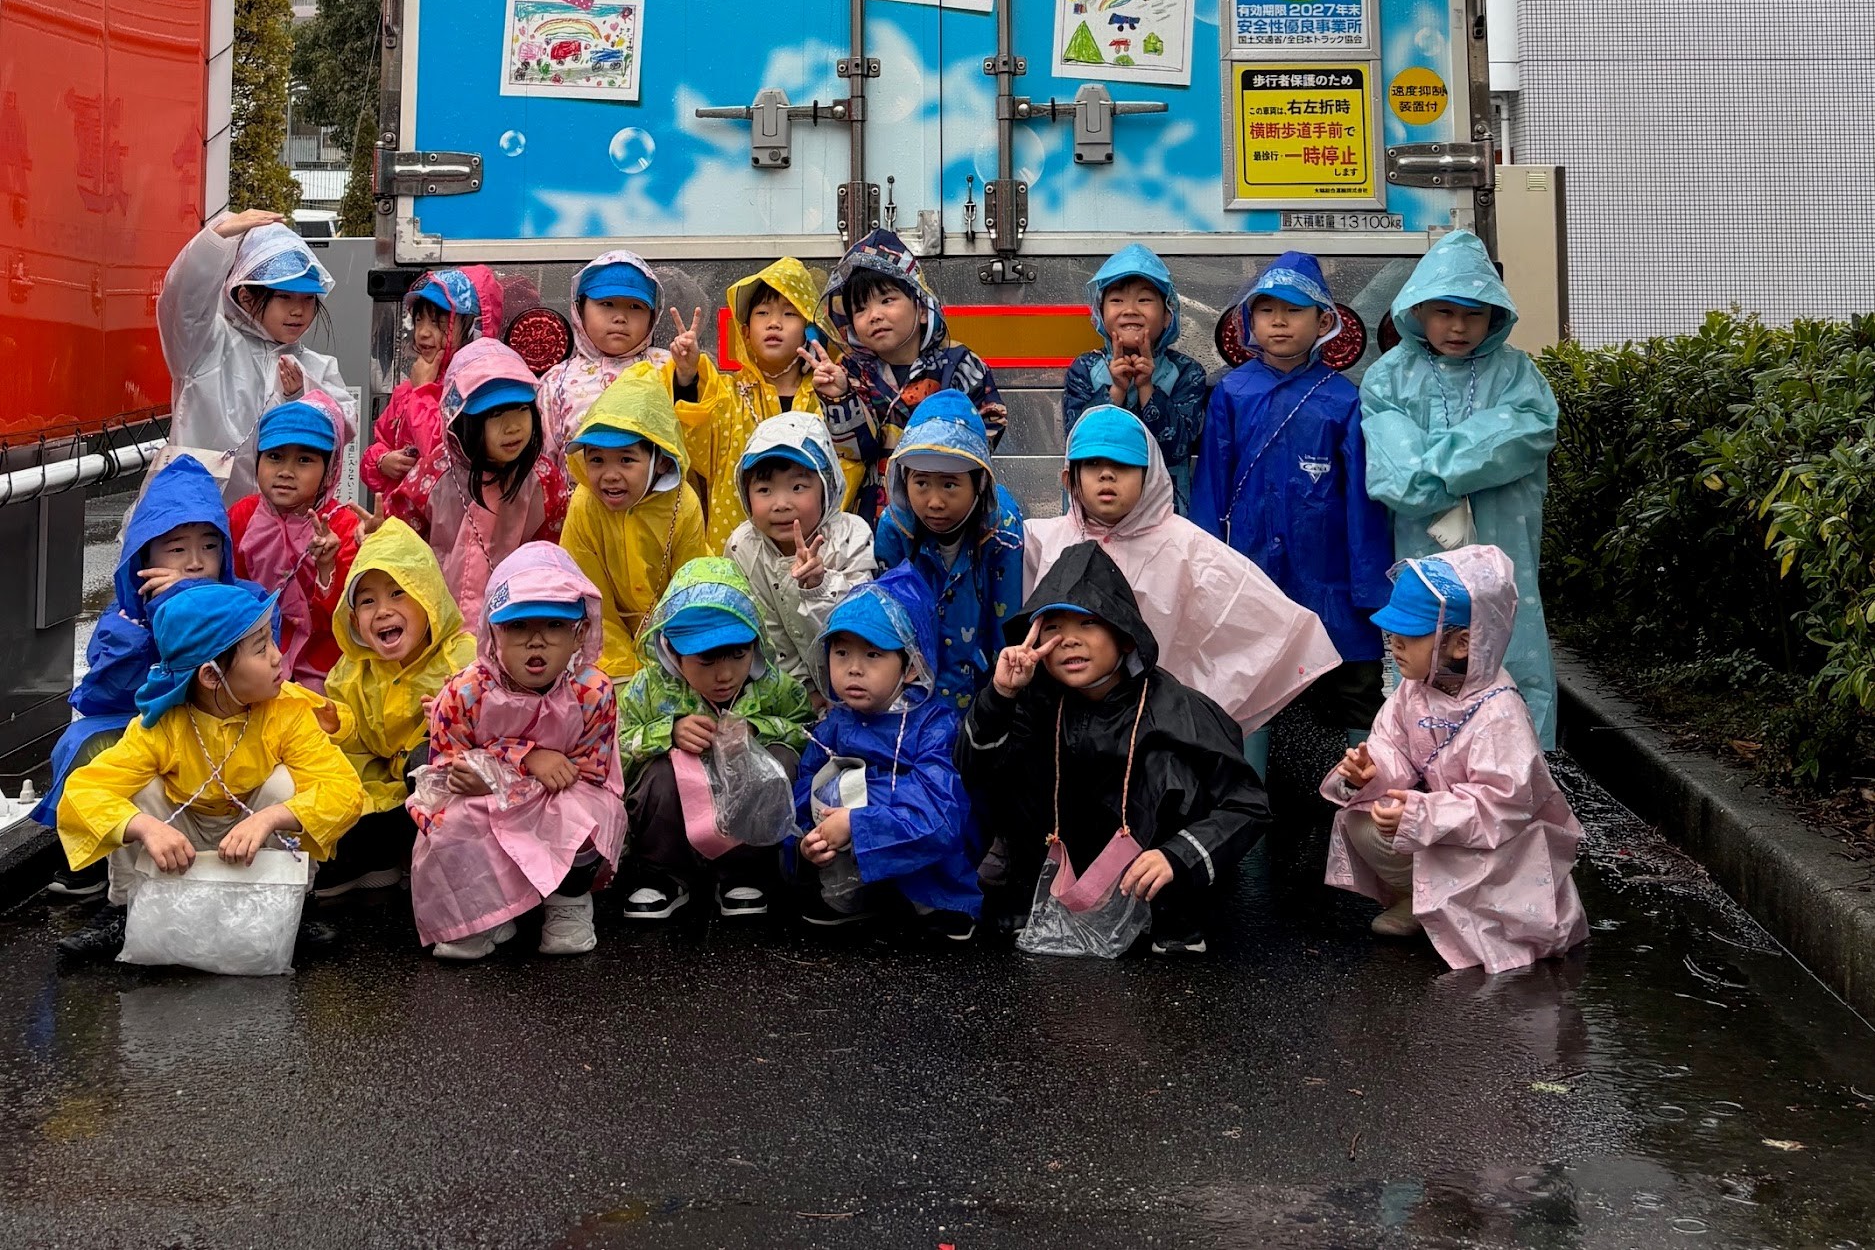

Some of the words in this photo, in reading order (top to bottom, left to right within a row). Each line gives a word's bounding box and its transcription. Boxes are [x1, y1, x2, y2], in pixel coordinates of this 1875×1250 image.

[1238, 5, 1287, 16] 有効期限
[1289, 4, 1361, 16] 2027年末
[1237, 19, 1361, 34] 安全性優良事業所
[1238, 35, 1362, 44] 国土交通省/全日本トラック協会
[1252, 74, 1353, 87] 歩行者保護のため
[1399, 101, 1438, 113] 装置付
[1249, 122, 1355, 139] 横断歩道手前で
[1334, 168, 1358, 177] します
[1340, 215, 1402, 229] 13100kg
